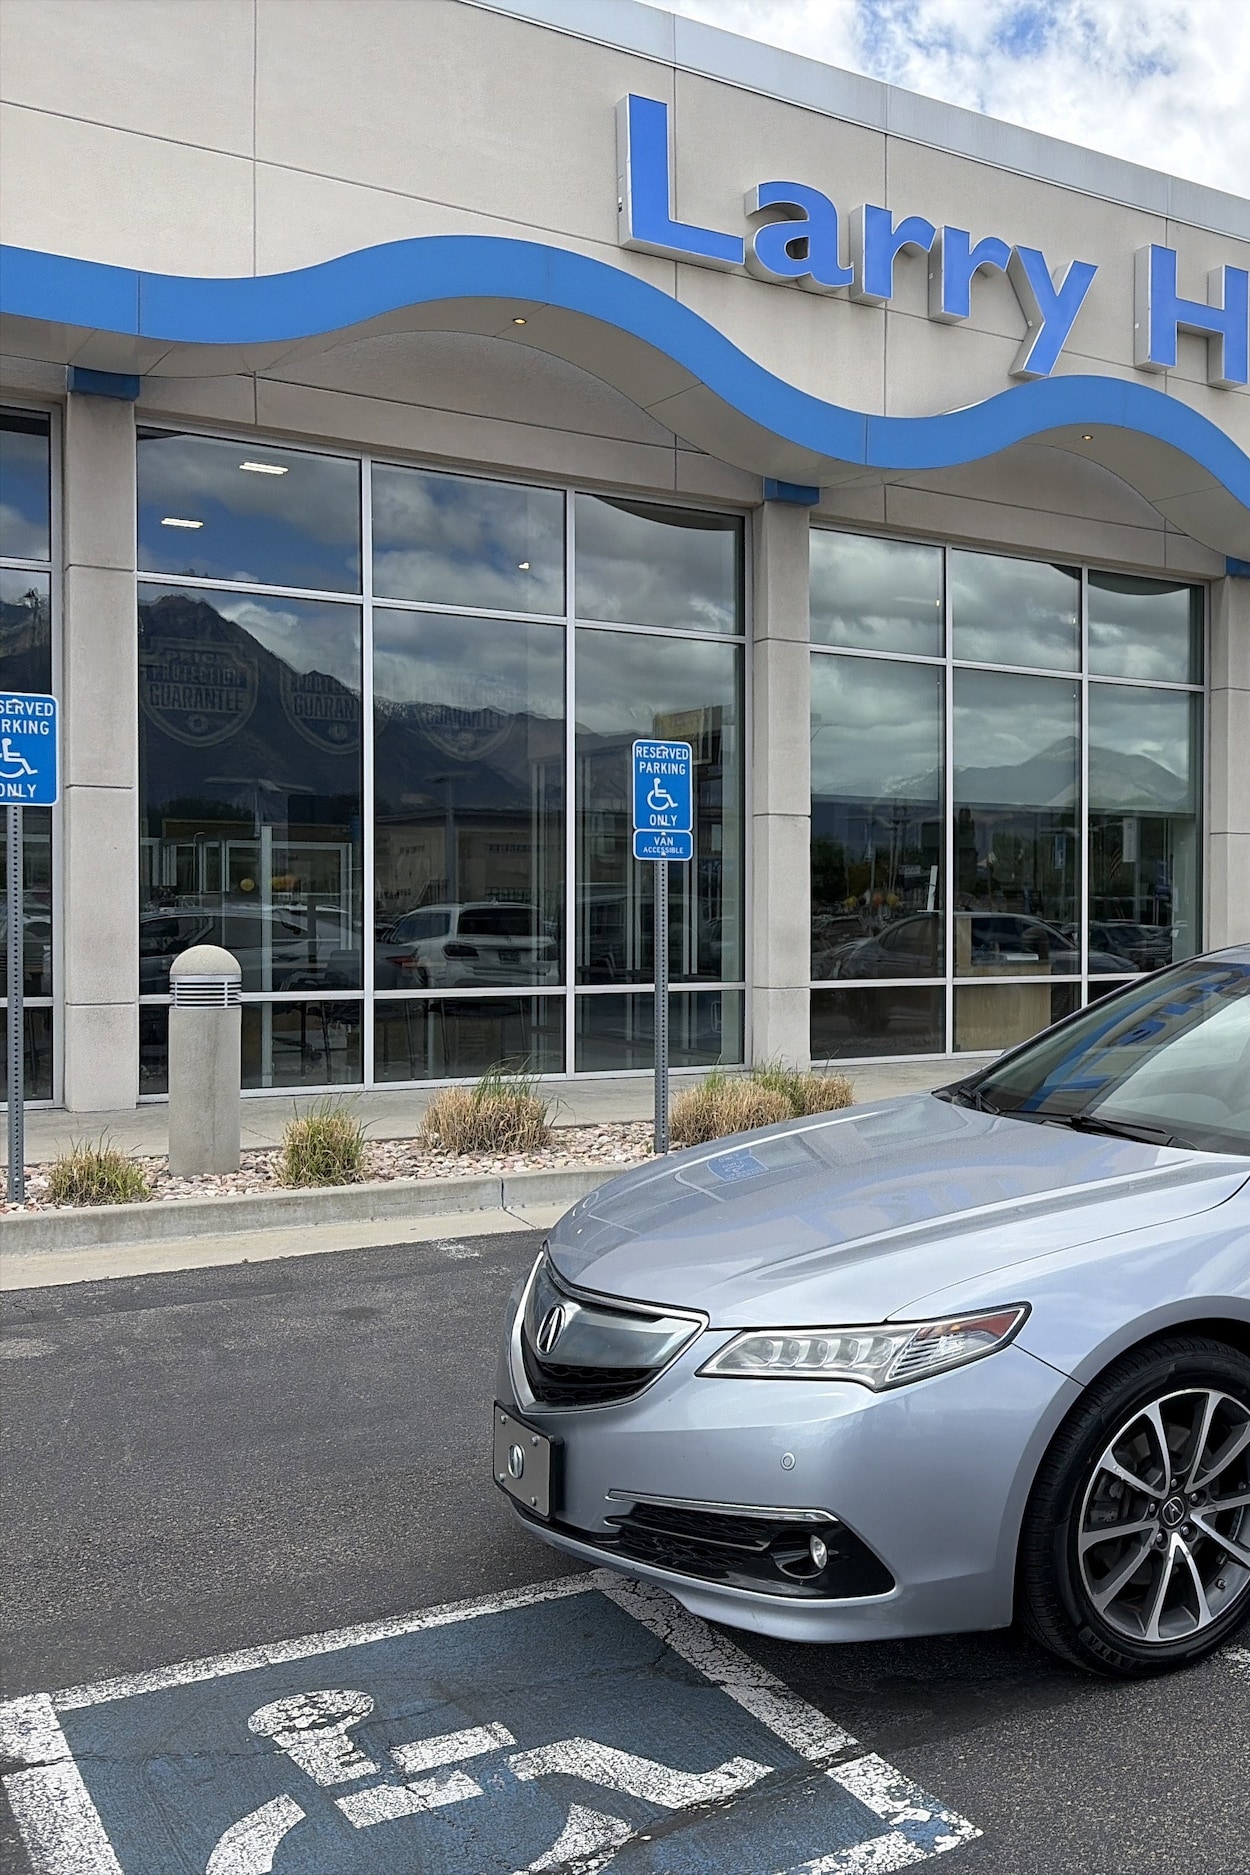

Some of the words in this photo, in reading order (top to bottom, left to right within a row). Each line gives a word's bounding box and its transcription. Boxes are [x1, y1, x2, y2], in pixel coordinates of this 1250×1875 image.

[616, 92, 1098, 378] Larry
[1135, 243, 1249, 388] H
[149, 686, 243, 711] GUARANTEE
[636, 745, 689, 760] RESERVED
[639, 761, 686, 775] PARKING
[649, 814, 678, 827] ONLY
[653, 836, 674, 847] VAN
[643, 846, 684, 854] ACCESSIBLE
